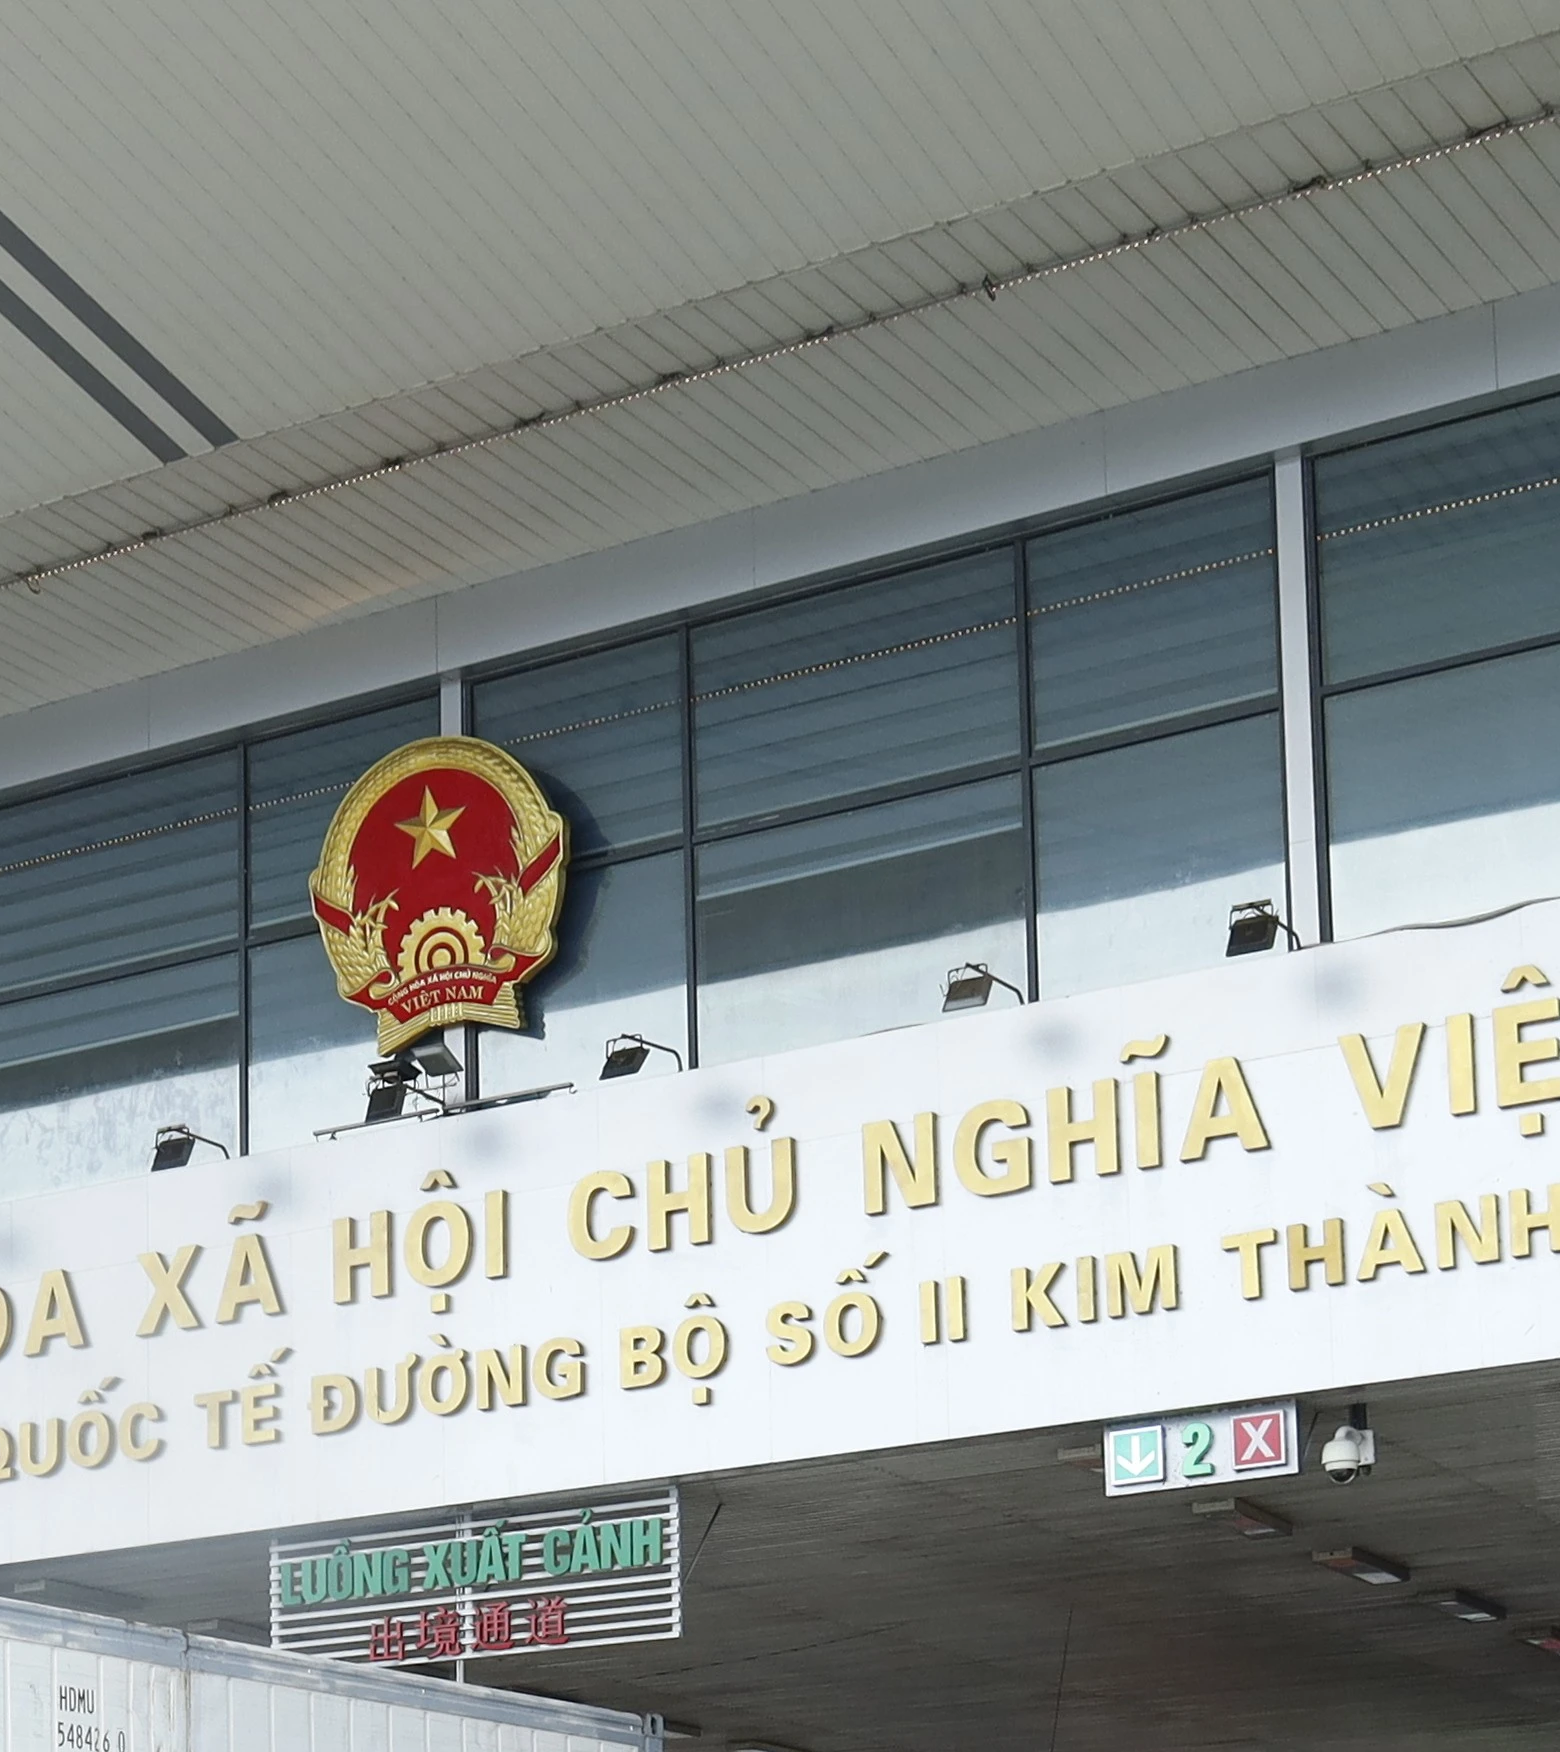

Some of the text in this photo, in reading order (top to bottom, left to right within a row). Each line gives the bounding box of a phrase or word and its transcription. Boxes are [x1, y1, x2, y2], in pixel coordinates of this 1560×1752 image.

[445, 985, 484, 1001] NAM
[136, 1200, 283, 1338] XÃ
[332, 1170, 510, 1313] HỘI
[567, 1098, 797, 1261] CHỦ
[862, 1034, 1270, 1216] NGHĨA
[195, 1347, 293, 1450] TẾ
[310, 1333, 586, 1436] ĐƯỜNG
[619, 1293, 729, 1405] BỘ
[767, 1251, 889, 1366] SỐ
[919, 1275, 968, 1344] II
[1009, 1241, 1180, 1332] KIM
[1182, 1422, 1215, 1477] 2
[280, 1508, 663, 1608] LUỒNG XUẤT CẢNH
[368, 1595, 571, 1664] 出境通道
[59, 1685, 95, 1714] HDMU
